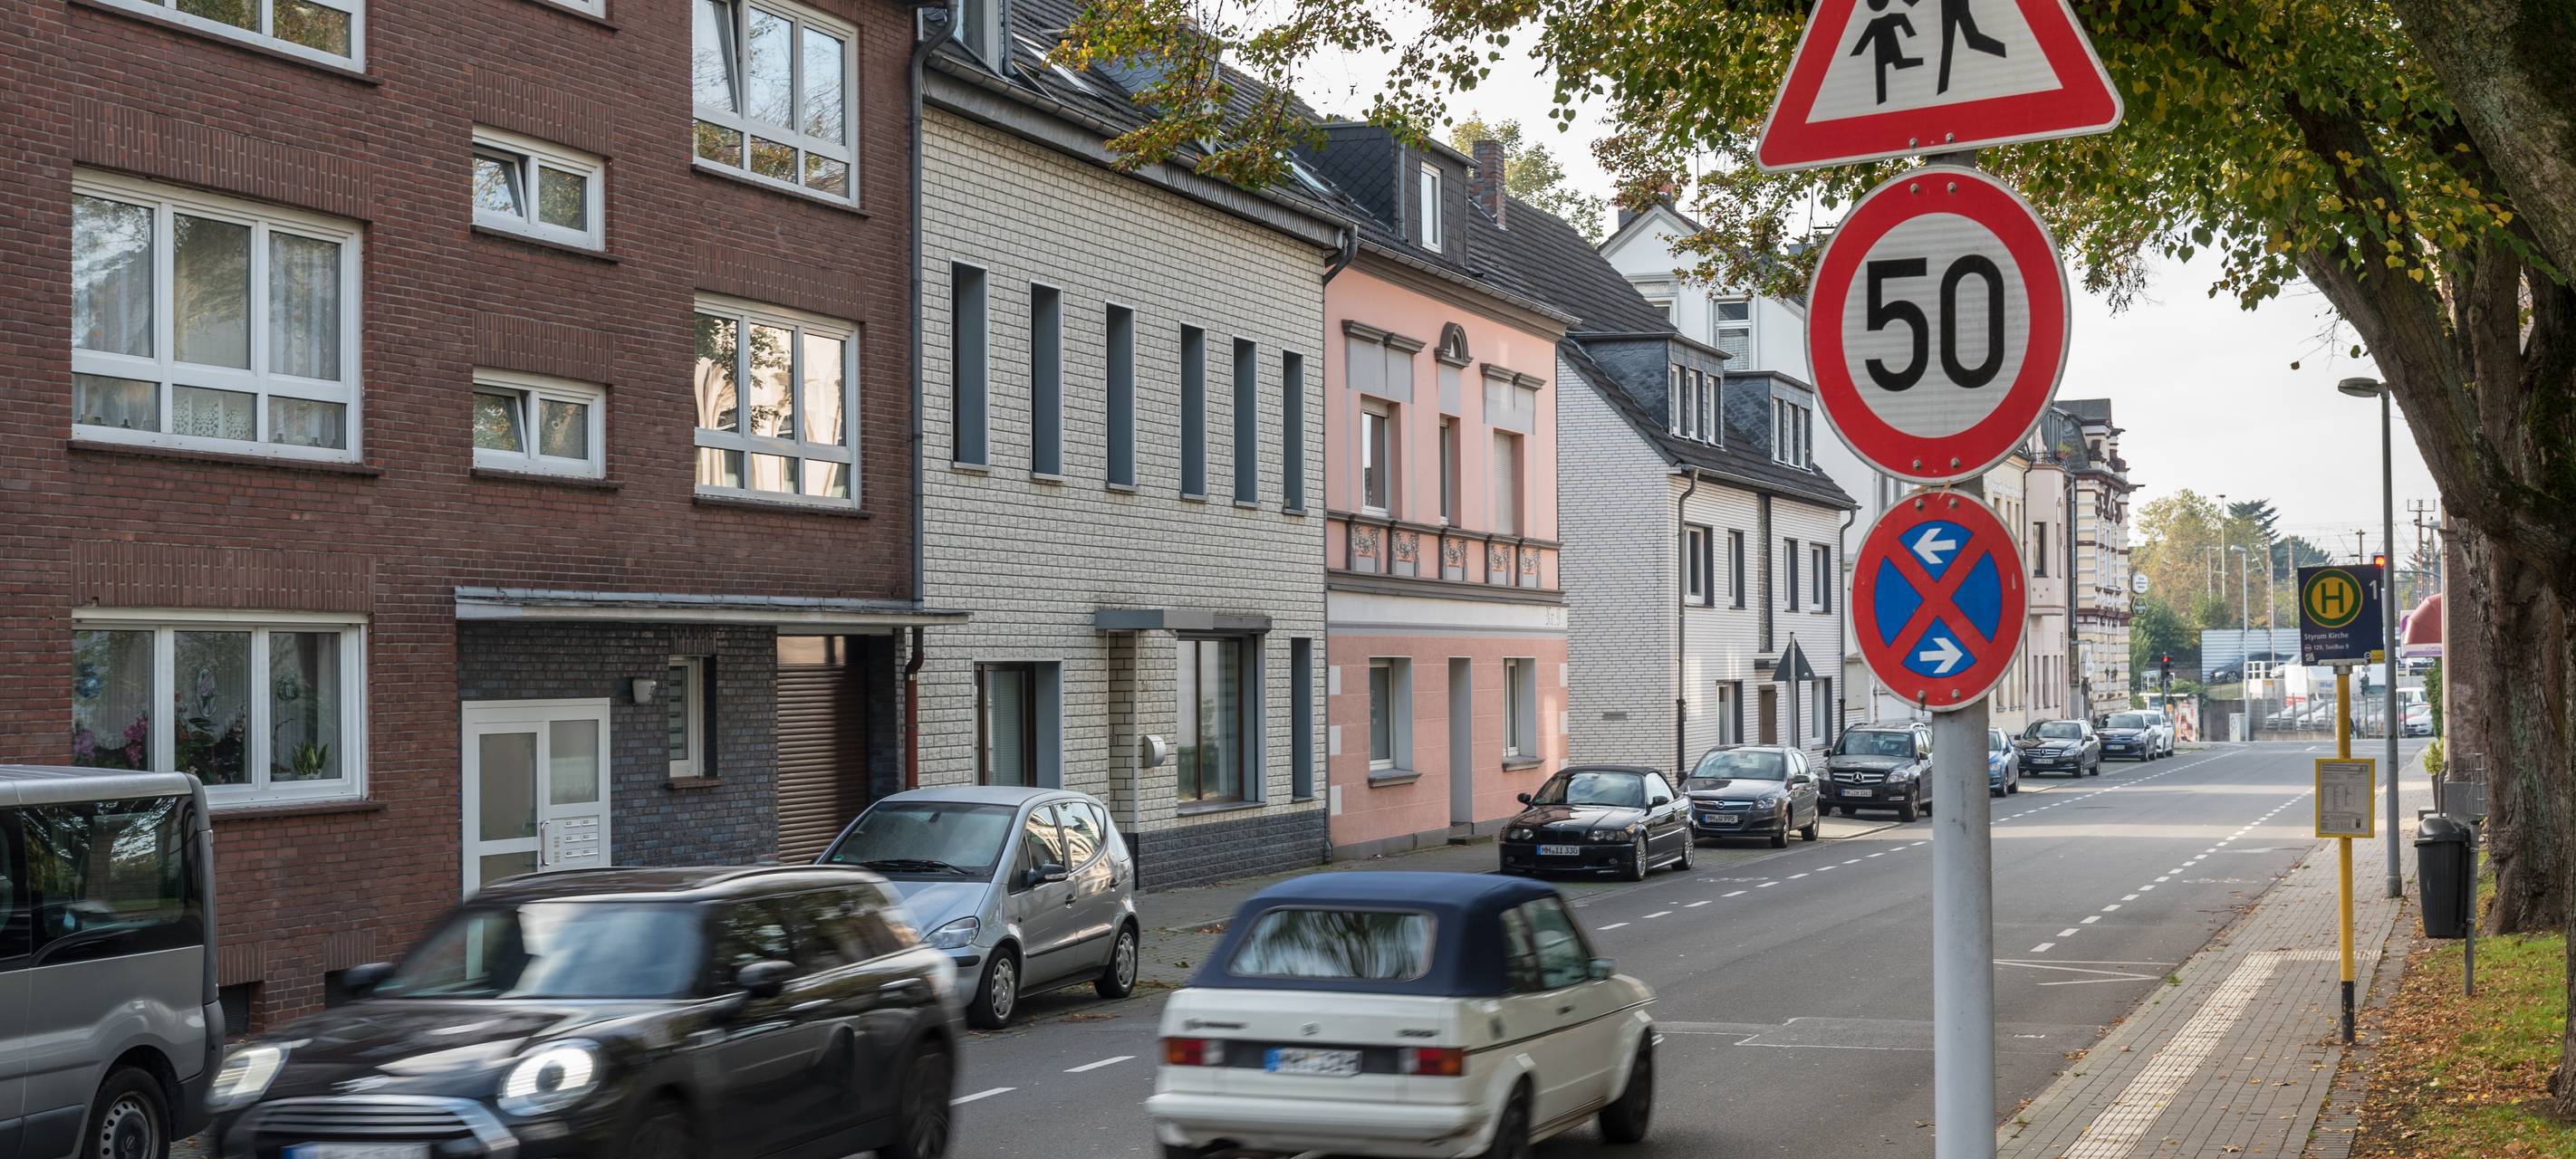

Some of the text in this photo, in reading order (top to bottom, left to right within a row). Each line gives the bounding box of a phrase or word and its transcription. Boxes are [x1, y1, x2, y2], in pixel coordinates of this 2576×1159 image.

[1865, 254, 2005, 391] 50
[2321, 581, 2344, 614] H
[2369, 580, 2378, 600] 1
[2303, 633, 2327, 641] Styrum
[1564, 847, 1578, 855] 330
